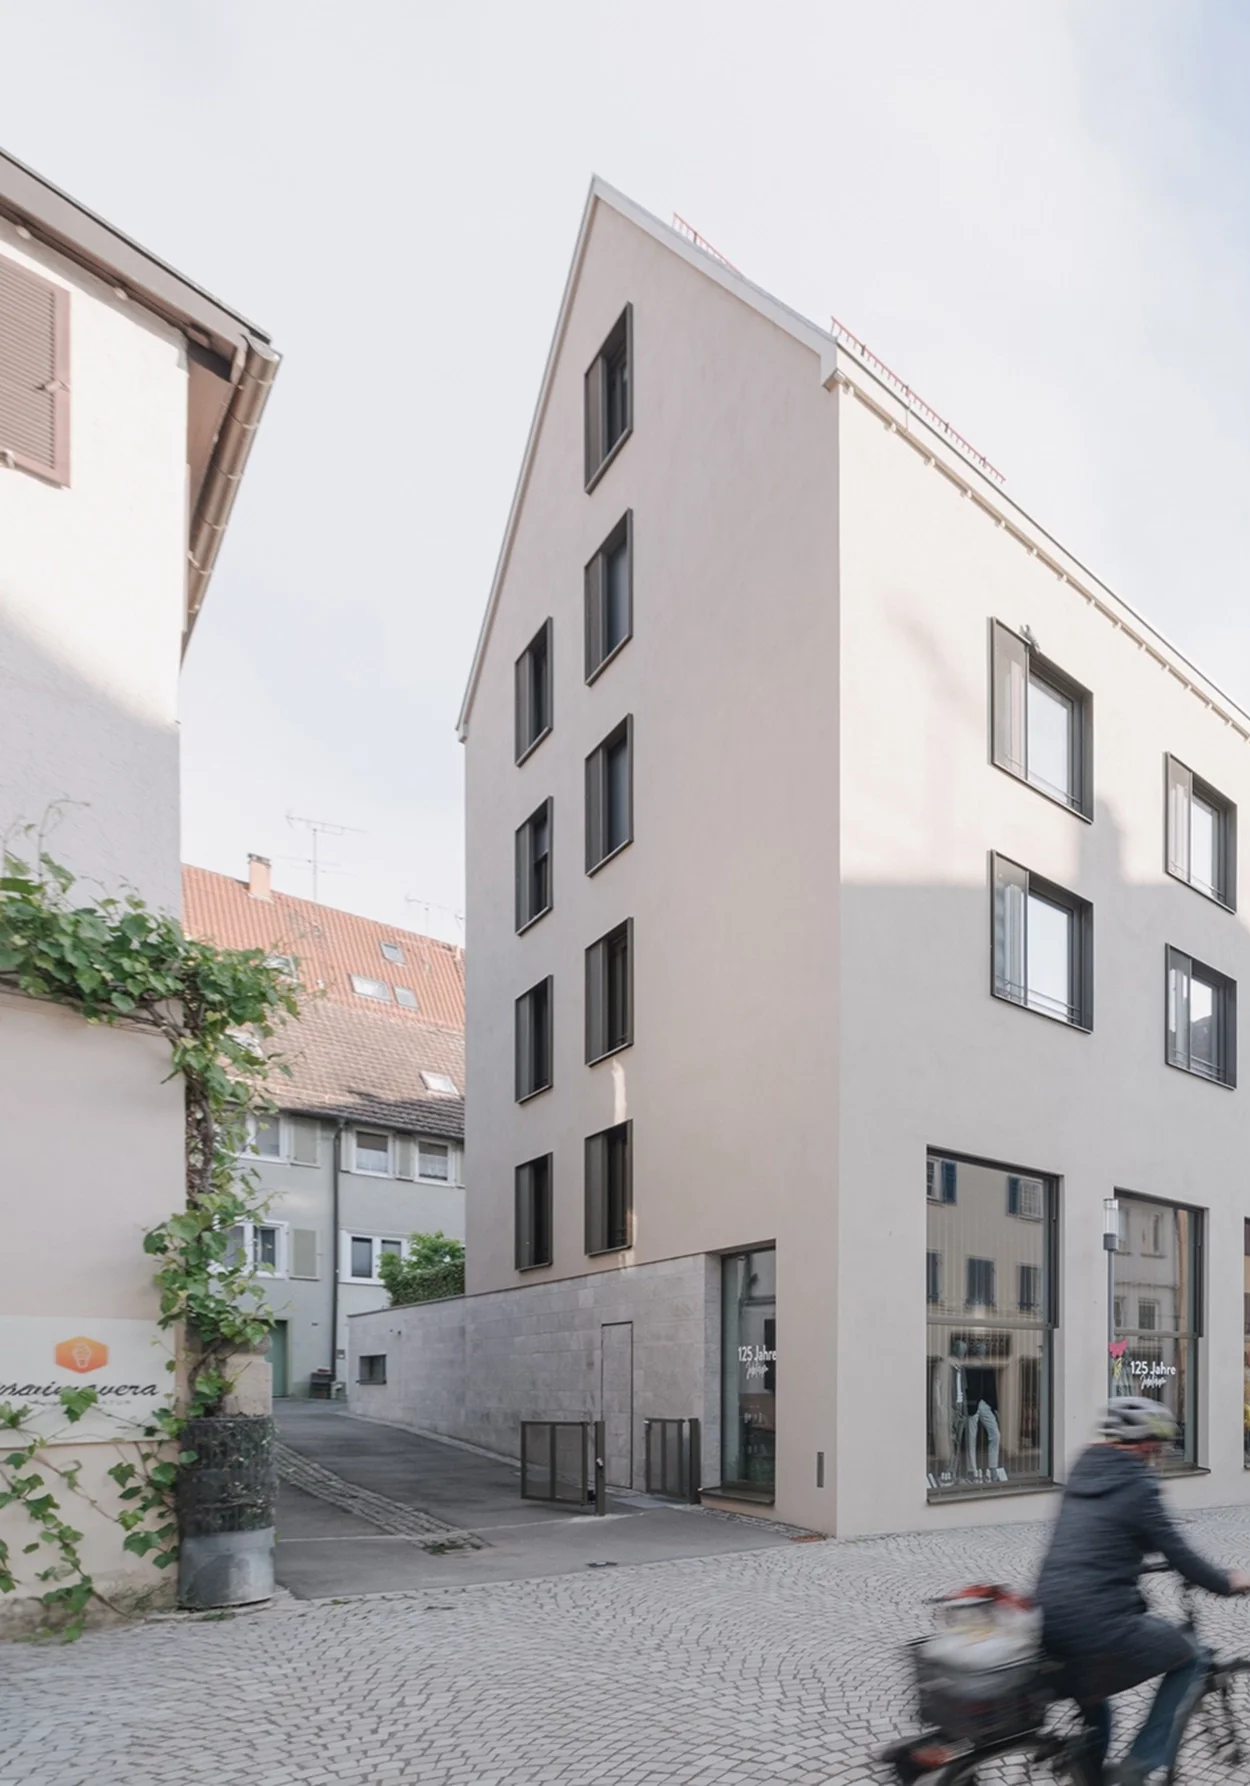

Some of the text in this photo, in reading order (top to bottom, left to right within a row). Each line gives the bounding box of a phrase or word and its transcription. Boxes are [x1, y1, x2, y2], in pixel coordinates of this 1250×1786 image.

[738, 1344, 777, 1361] 125 Jahre
[1130, 1360, 1176, 1375] 125 Jahre
